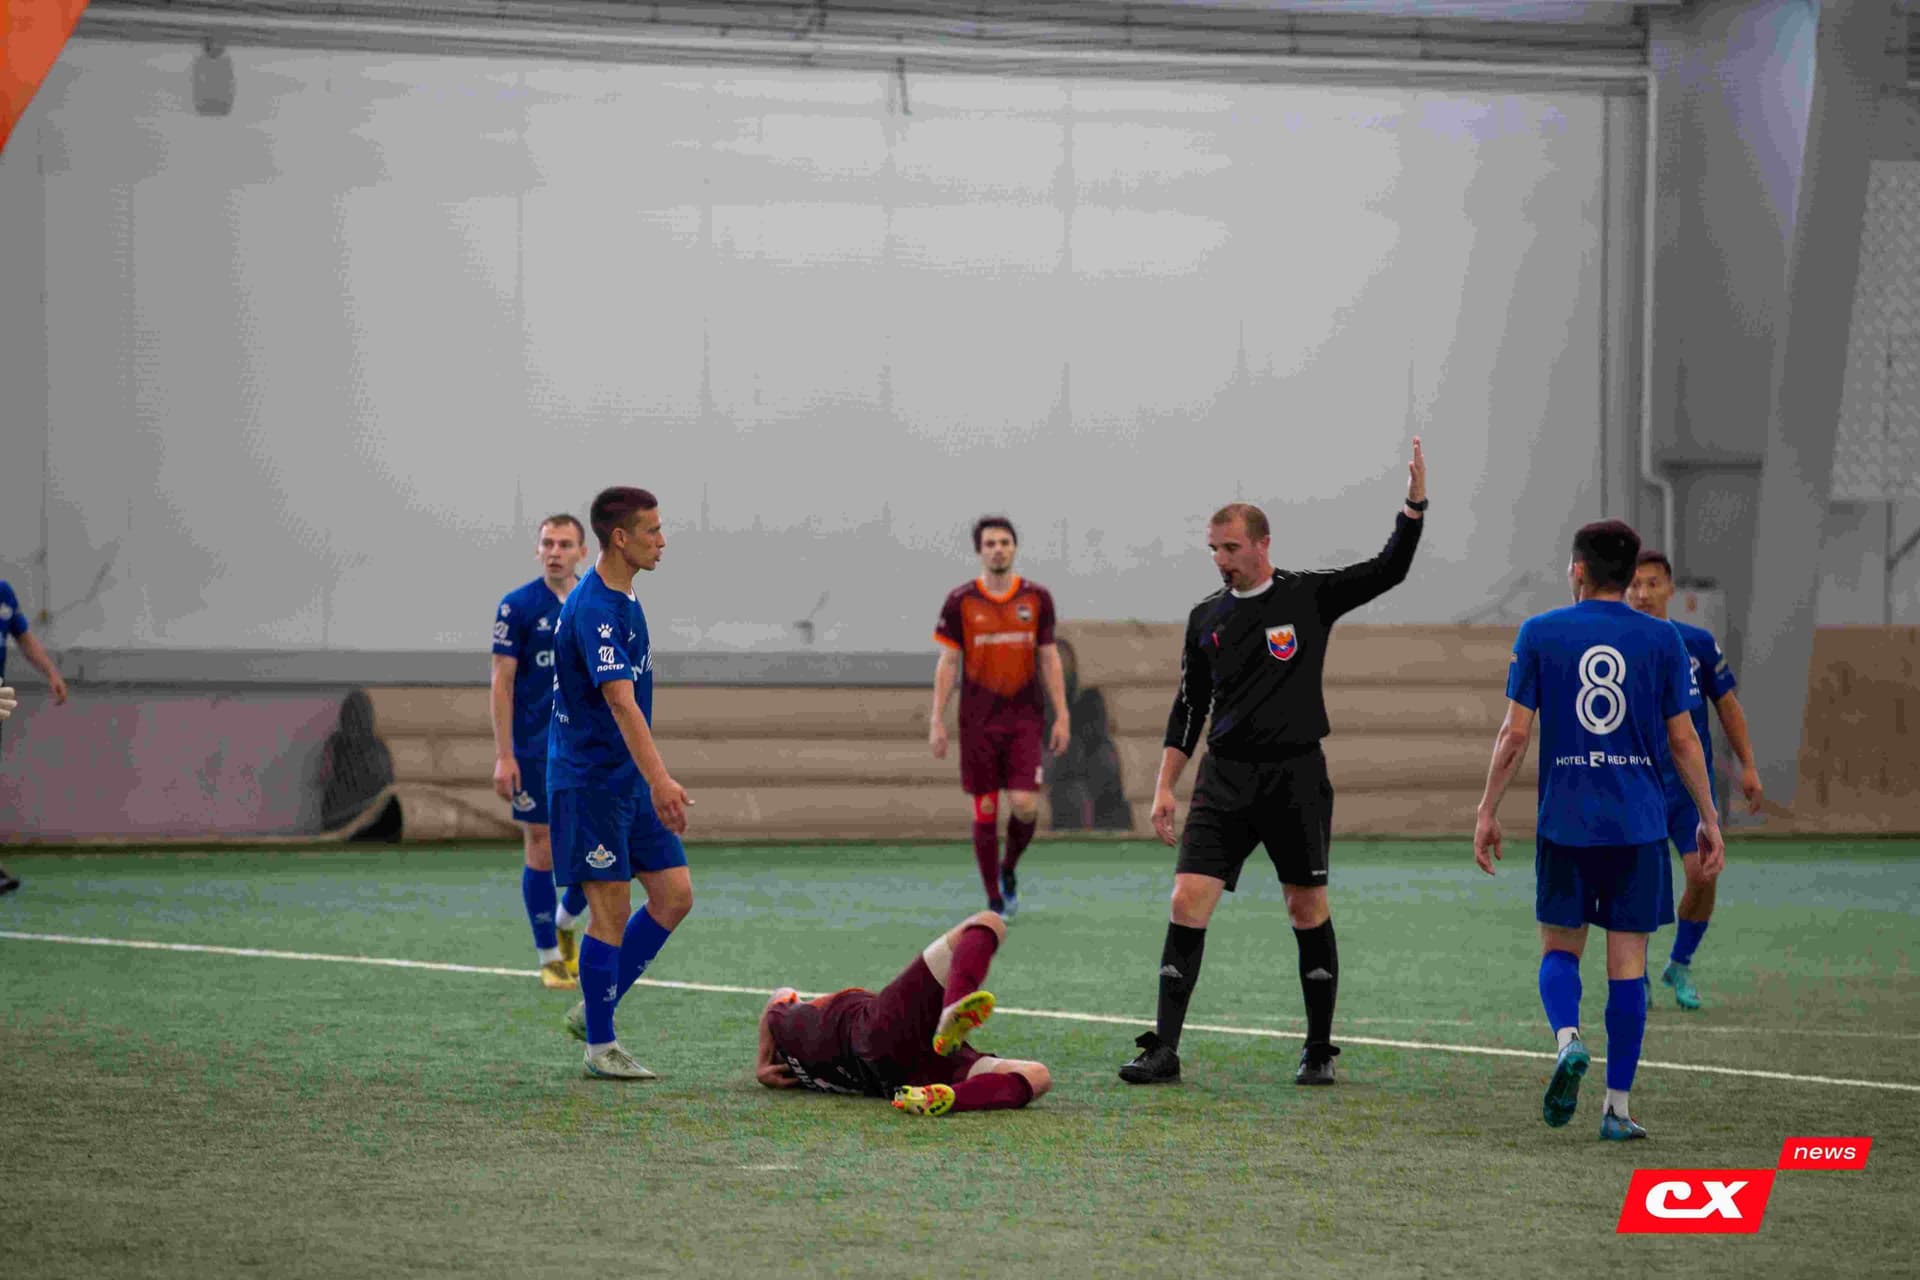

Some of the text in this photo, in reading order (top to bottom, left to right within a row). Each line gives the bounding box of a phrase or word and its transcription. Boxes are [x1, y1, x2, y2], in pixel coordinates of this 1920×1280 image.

[1576, 645, 1626, 735] 8
[1556, 756, 1587, 766] HOTEL
[1608, 755, 1627, 765] RED
